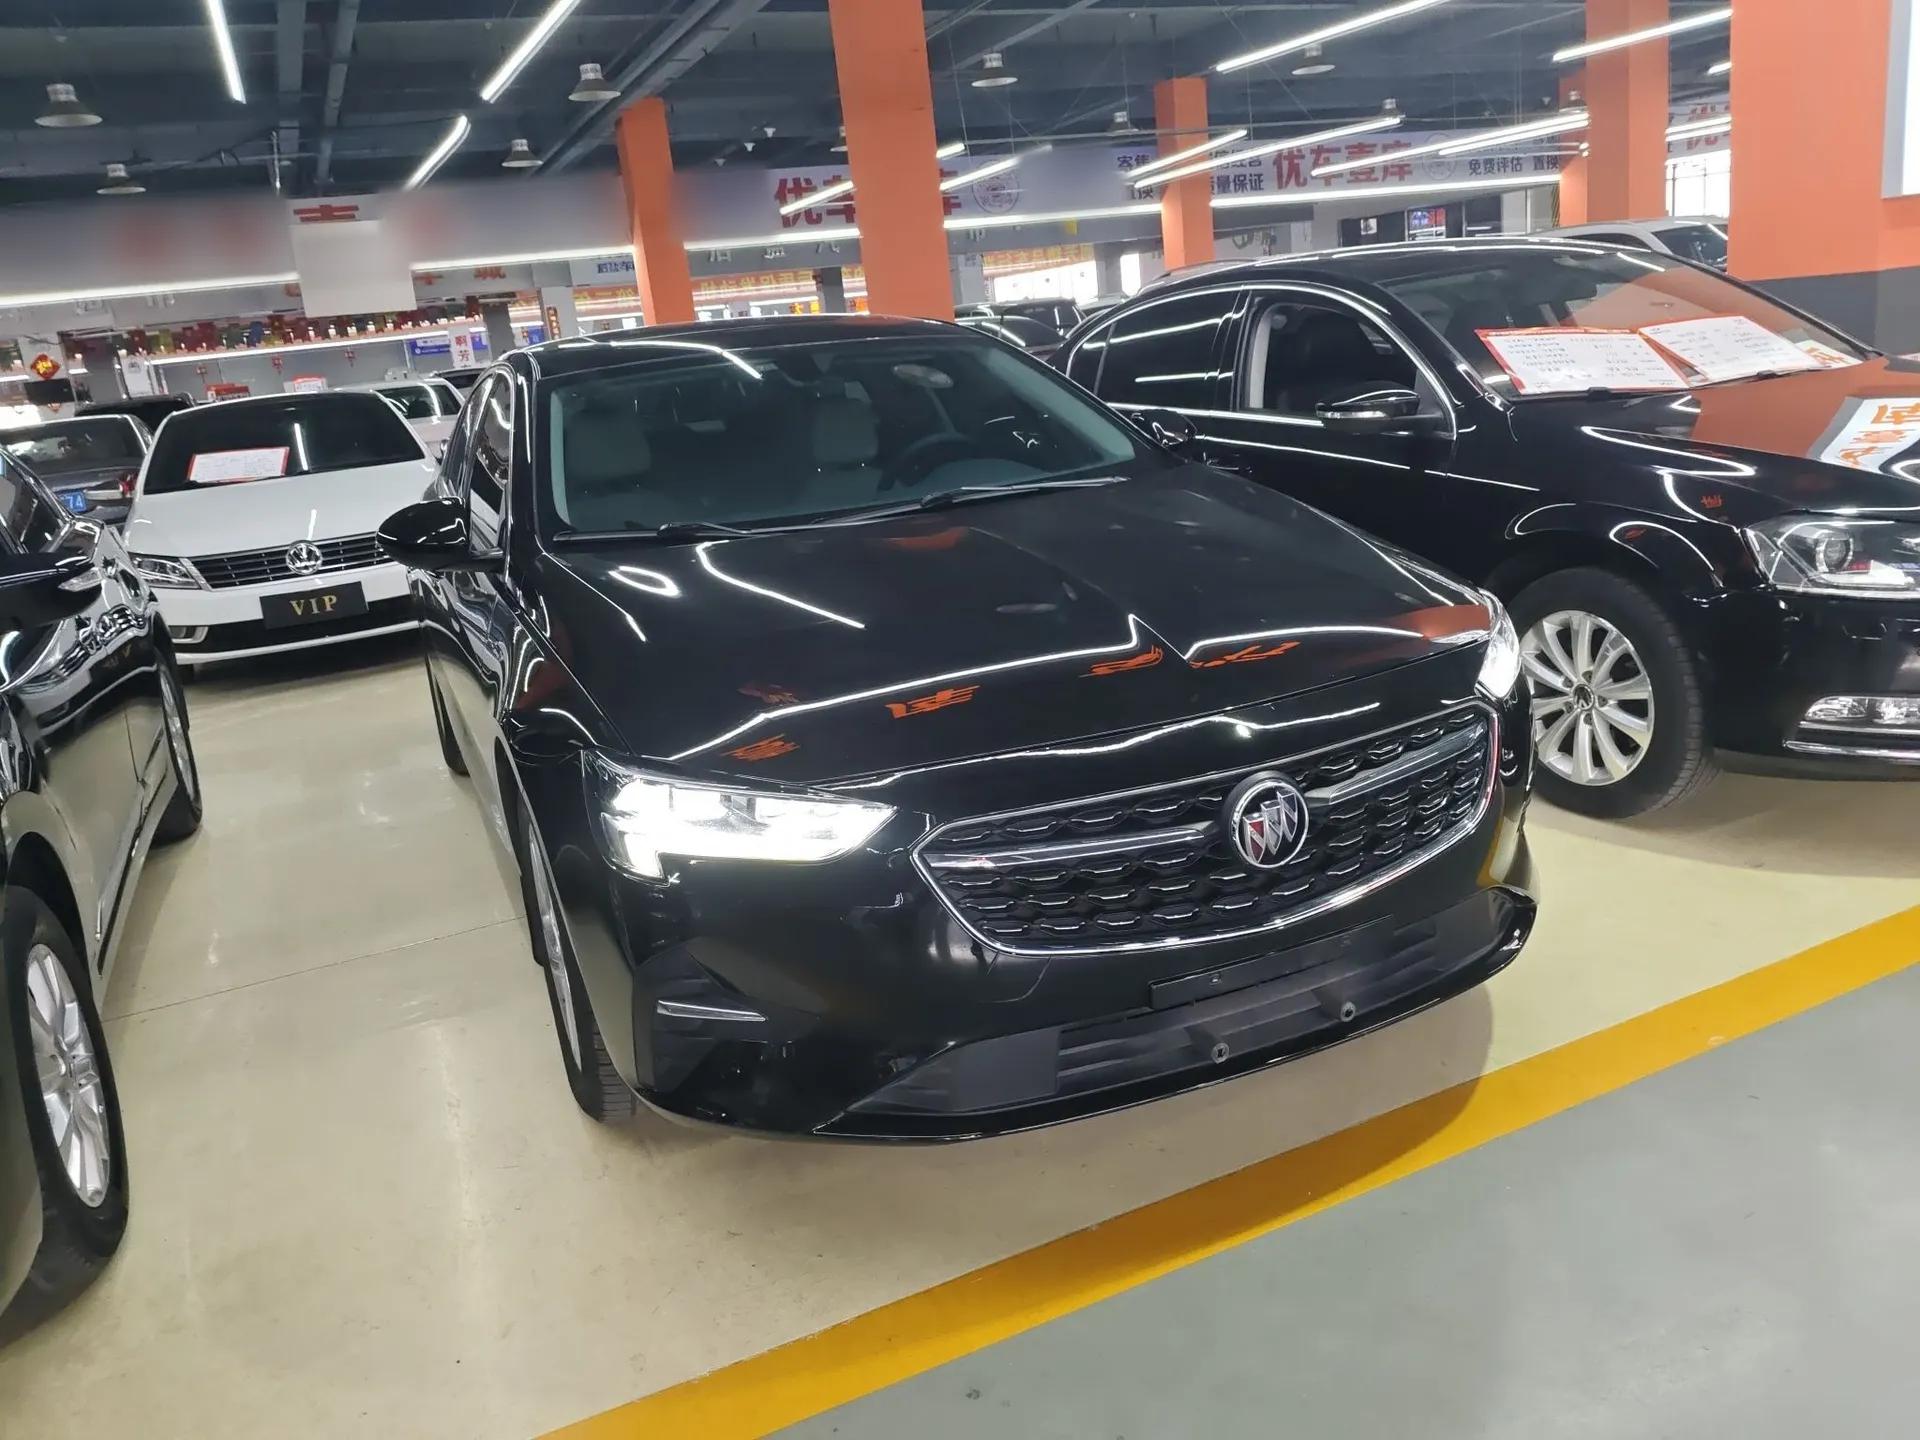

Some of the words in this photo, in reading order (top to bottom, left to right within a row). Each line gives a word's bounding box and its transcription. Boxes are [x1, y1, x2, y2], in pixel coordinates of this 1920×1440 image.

[1468, 156, 1523, 176] 免费评估
[1209, 172, 1264, 196] 量保证
[290, 595, 337, 616] VIP
